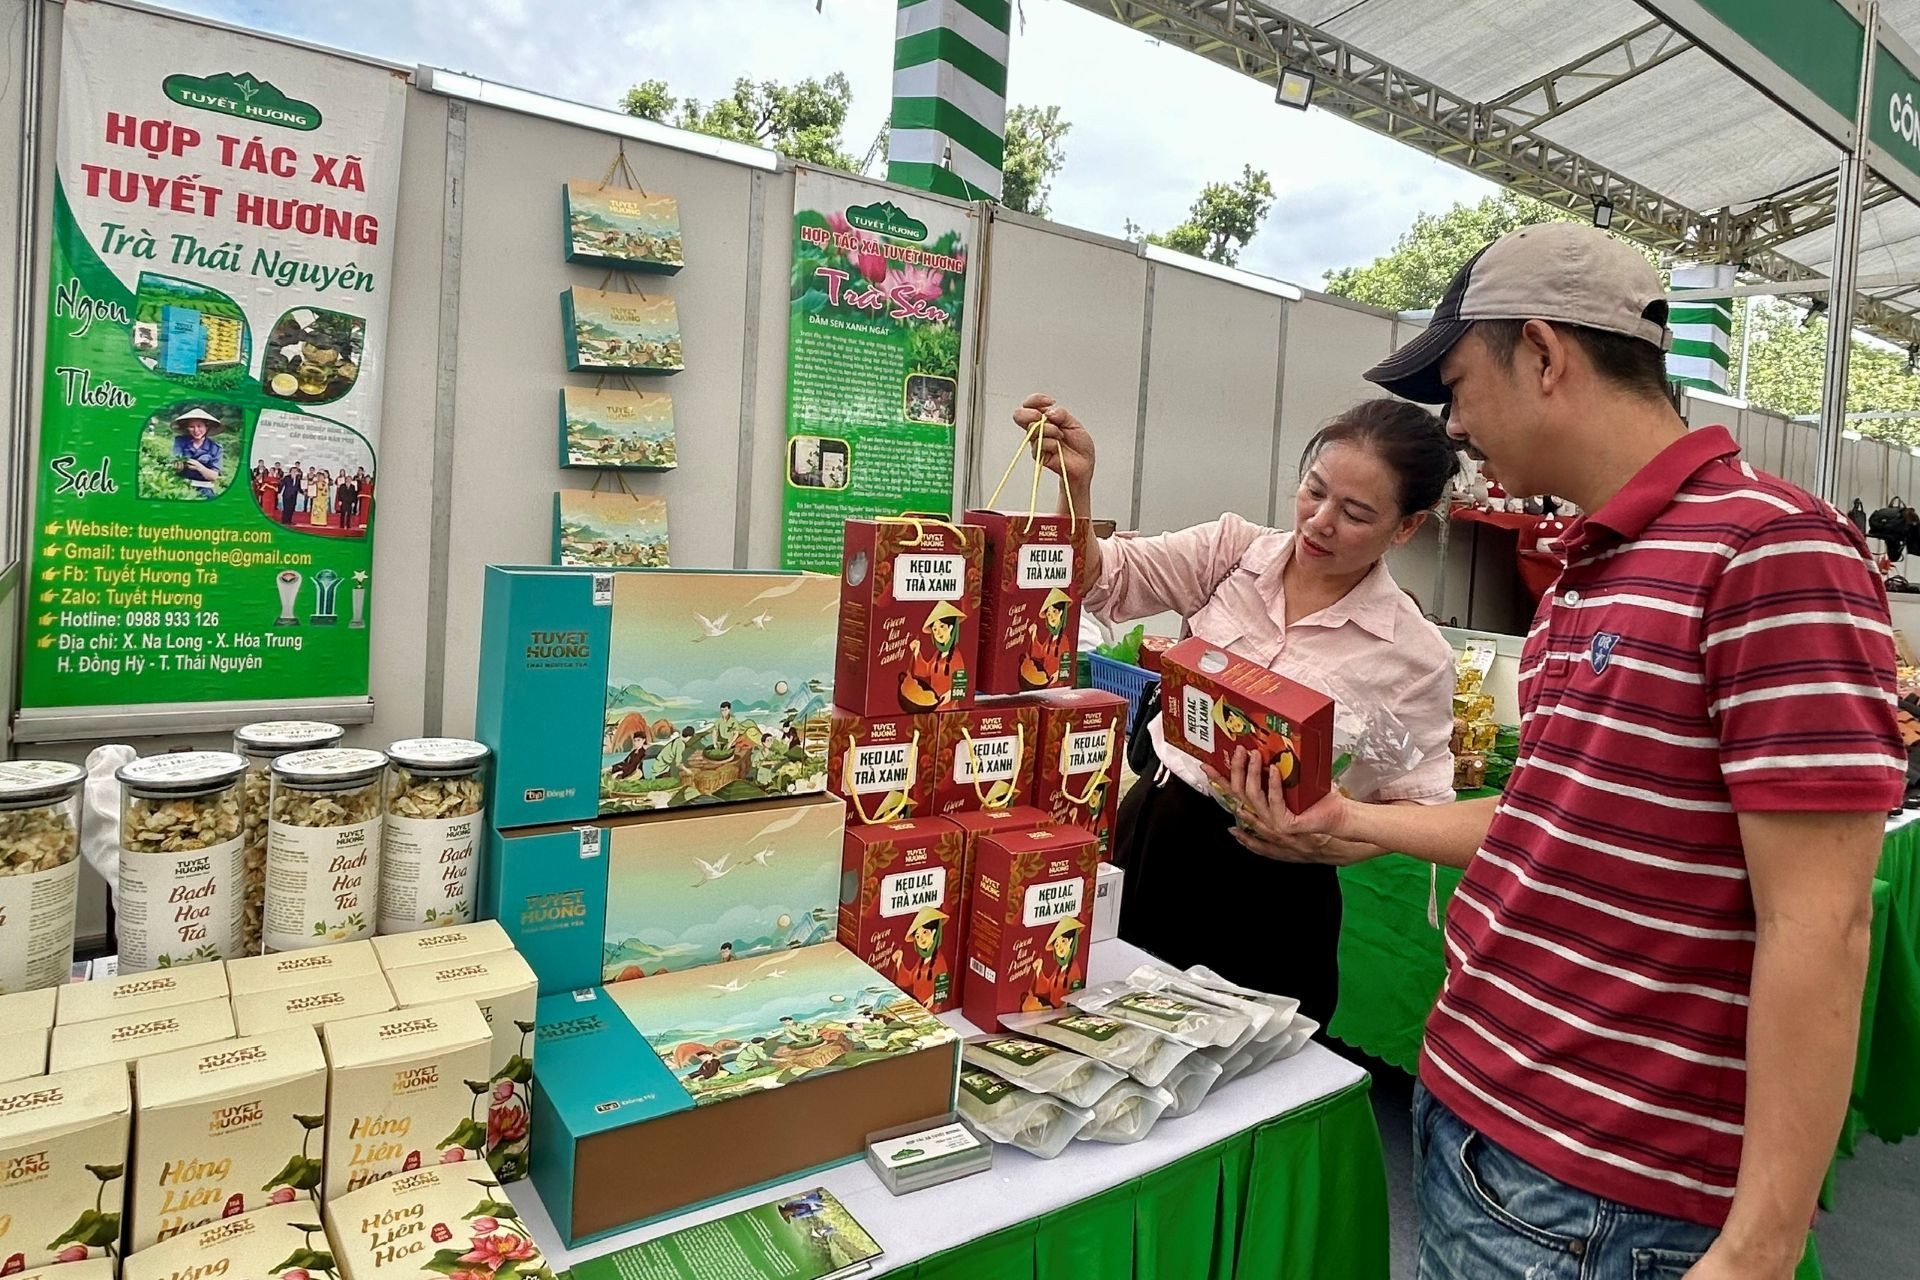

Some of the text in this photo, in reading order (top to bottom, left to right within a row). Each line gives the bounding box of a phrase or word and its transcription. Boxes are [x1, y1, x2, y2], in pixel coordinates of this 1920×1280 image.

[246, 103, 307, 126] HƯƠNG
[105, 111, 366, 193] HỢP TÁC XÃ
[80, 164, 379, 246] TUYẾT HƯƠNG
[100, 221, 375, 293] Trà Thái Nguyên
[801, 225, 964, 274] HỢP TÁC XÃ TUYẾT HƯƠNG
[816, 266, 950, 322] Trà Sen
[56, 277, 131, 338] Ngon
[830, 319, 845, 330] SEN
[845, 322, 869, 333] XANH
[56, 366, 137, 409] Thơm
[51, 455, 119, 499] Sạch
[66, 518, 272, 545] Website: tuyethuongtra.com
[64, 542, 312, 567] Gmail: tuyethuongche@gmail.com
[1030, 549, 1064, 565] KẸO LẠC
[63, 563, 218, 588] Fb: Tuyết Hương Trà
[910, 559, 953, 576] KẸO LẠC
[1026, 563, 1067, 580] TRÀ XANH
[905, 575, 957, 592] TRÀ XANH
[61, 585, 203, 609] Zalo: Tuyết Hương
[60, 610, 219, 627] Hotline: 0988 933 126
[58, 631, 303, 654] Địa chỉ: X. Na Long X. Hóa Trung
[57, 652, 262, 676] H. Đồng Hỷ T. Thái Nguyên
[880, 647, 906, 666] candy
[1187, 696, 1198, 714] LẠC
[1199, 697, 1209, 723] XANH
[991, 741, 1009, 757] LẠC
[1074, 734, 1107, 751] KẸO LẠC
[860, 749, 904, 767] KẸO LẠC
[986, 757, 1013, 773] XANH
[1069, 749, 1085, 767] TRÀ
[855, 765, 909, 785] TRÀ XANH
[328, 848, 368, 874] Bạch
[439, 840, 474, 865] Bạch
[332, 874, 362, 892] Hoa
[442, 864, 468, 881] Hoa
[895, 873, 934, 893] KẸO LẠC
[167, 876, 216, 904] Bạch
[444, 881, 464, 899] Trà
[891, 889, 938, 909] TRÀ XANH
[1038, 883, 1074, 903] KẸO LẠC
[334, 892, 359, 911] Trà
[1033, 899, 1077, 919] TRÀ XANH
[174, 904, 210, 923] Hoa
[178, 922, 208, 943] Trà
[348, 1141, 404, 1167] Liên
[158, 1187, 224, 1216] Liên
[370, 1220, 427, 1252] Liên
[375, 1240, 426, 1268] Hoa
